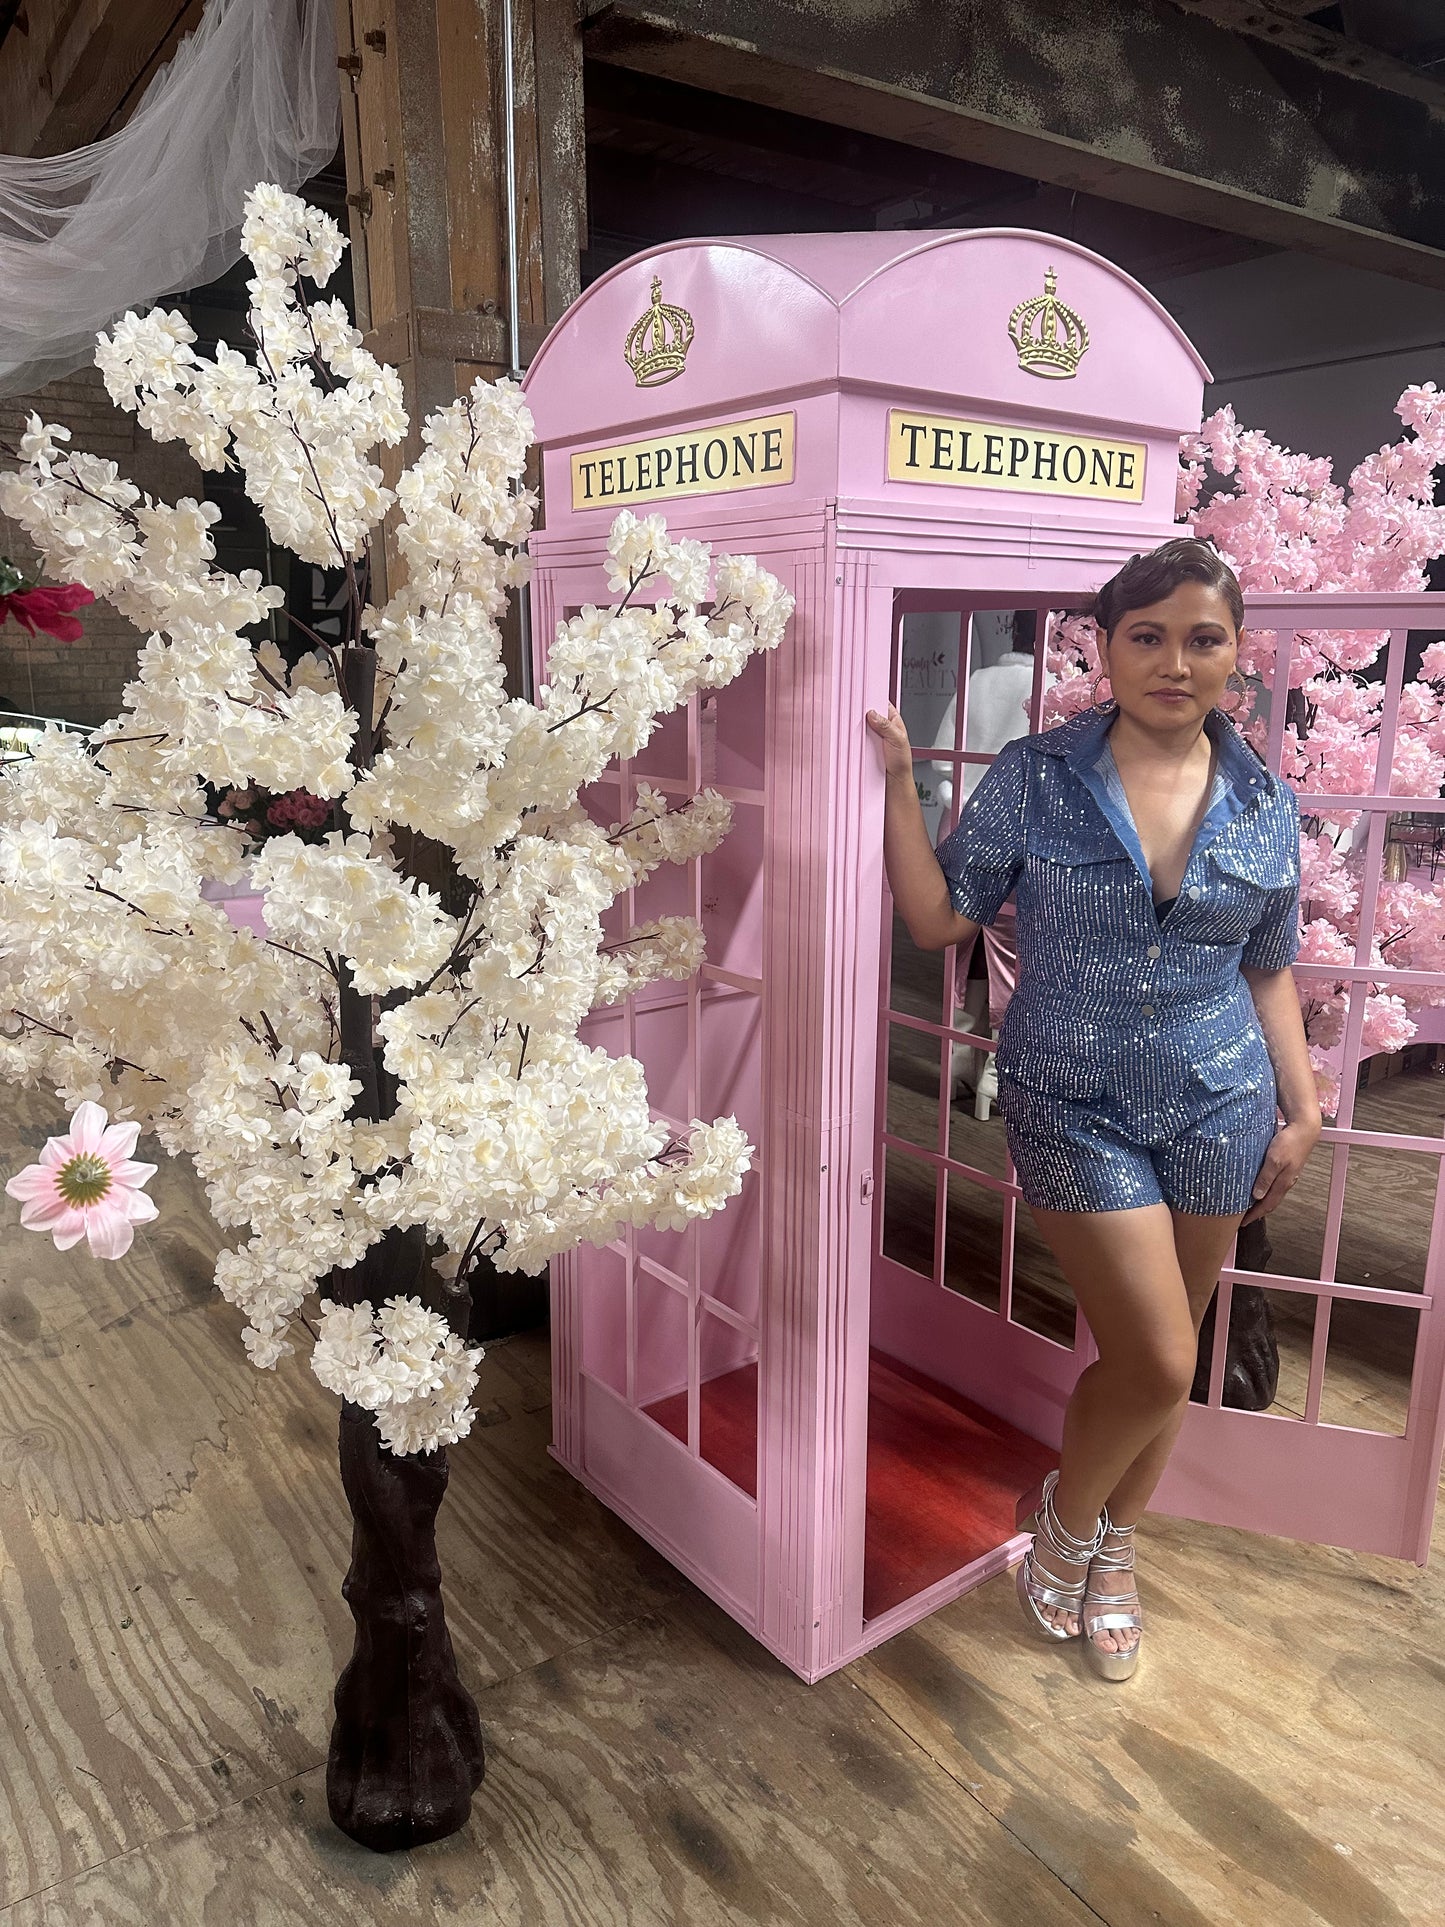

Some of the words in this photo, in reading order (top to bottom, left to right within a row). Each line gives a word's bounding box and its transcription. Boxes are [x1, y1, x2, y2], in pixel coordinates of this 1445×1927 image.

[579, 428, 783, 499] TELEPHONE
[900, 423, 1135, 490] TELEPHONE
[902, 669, 957, 690] EAUTY
